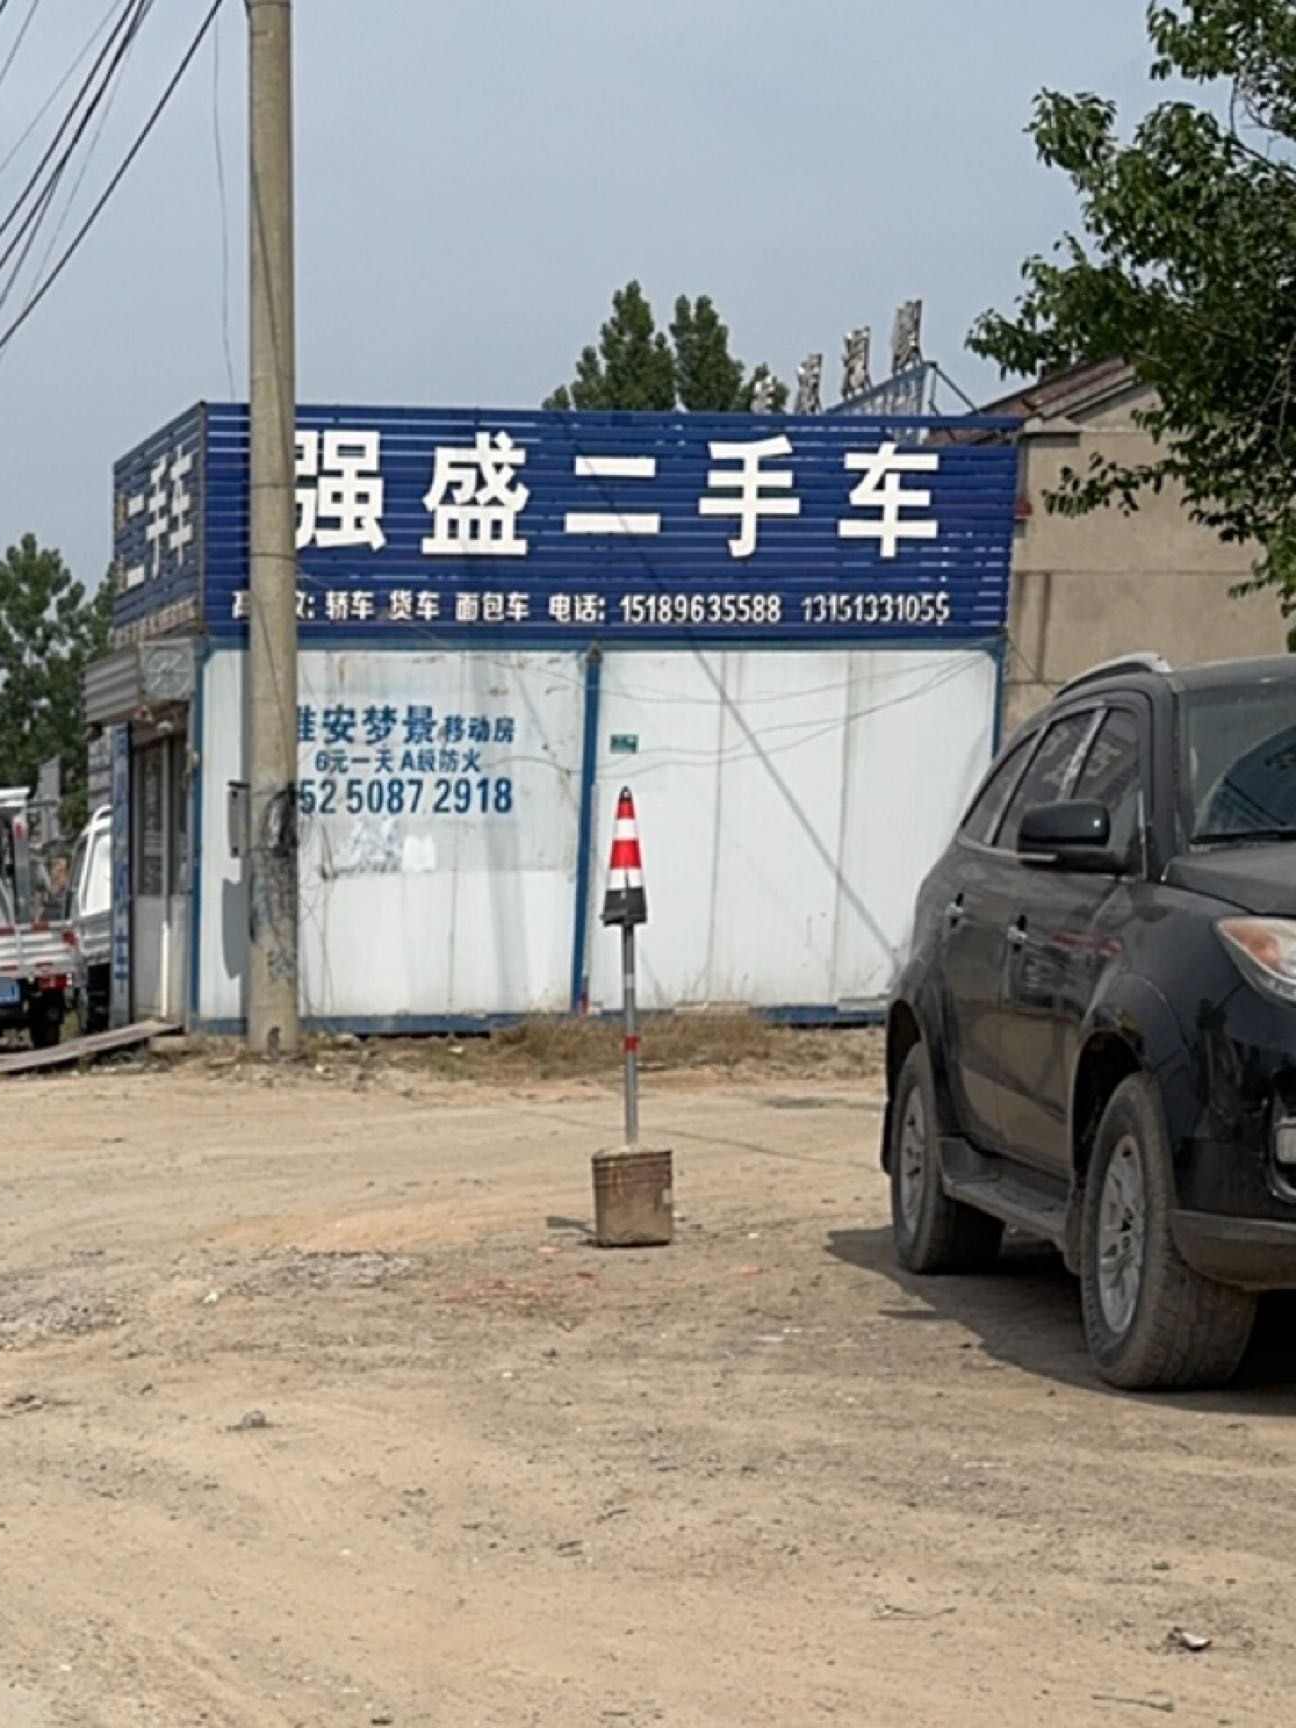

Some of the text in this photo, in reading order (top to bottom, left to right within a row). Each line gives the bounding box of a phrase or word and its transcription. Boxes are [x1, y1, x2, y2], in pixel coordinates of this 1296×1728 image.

[295, 429, 940, 560] 强盛二手车
[324, 590, 375, 621] 轿车
[389, 589, 440, 621] 货车
[456, 590, 530, 623] 面包车
[548, 593, 606, 623] 电话:
[619, 593, 782, 625] 15189635588
[345, 778, 424, 815] 5087
[433, 778, 513, 815] 2918
